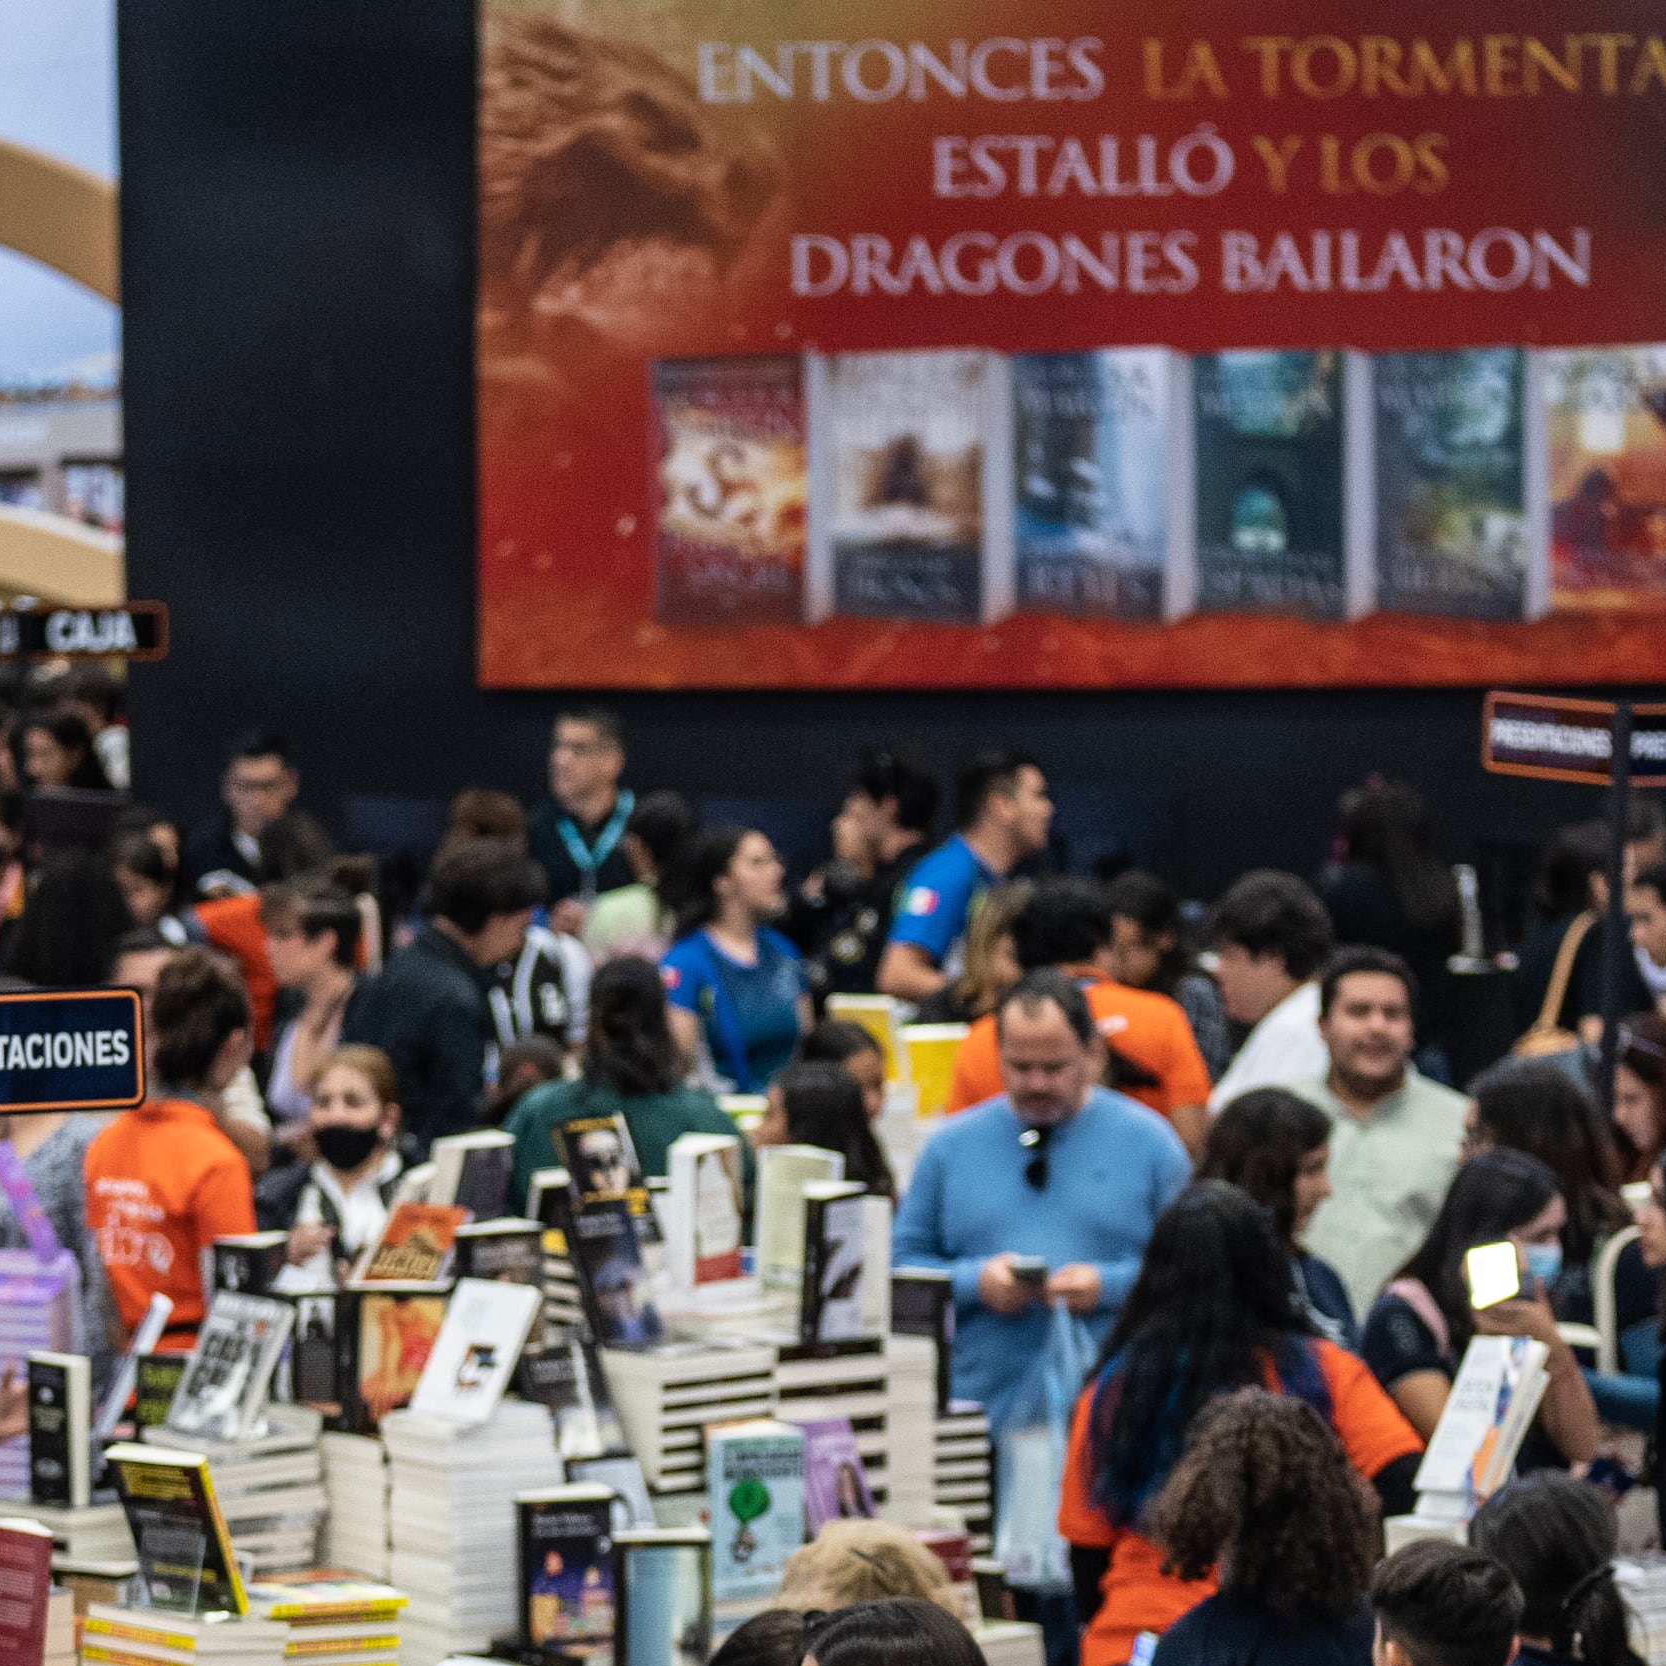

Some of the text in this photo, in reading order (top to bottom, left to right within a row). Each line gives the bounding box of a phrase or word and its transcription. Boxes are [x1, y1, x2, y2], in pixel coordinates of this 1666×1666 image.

[697, 37, 1105, 105] ENTONCES
[1142, 37, 1229, 99] LA
[934, 123, 1450, 198] ESTALLÓ Y LOS
[790, 228, 1592, 297] DRAGONES BAILARON
[44, 609, 139, 653] CAJA
